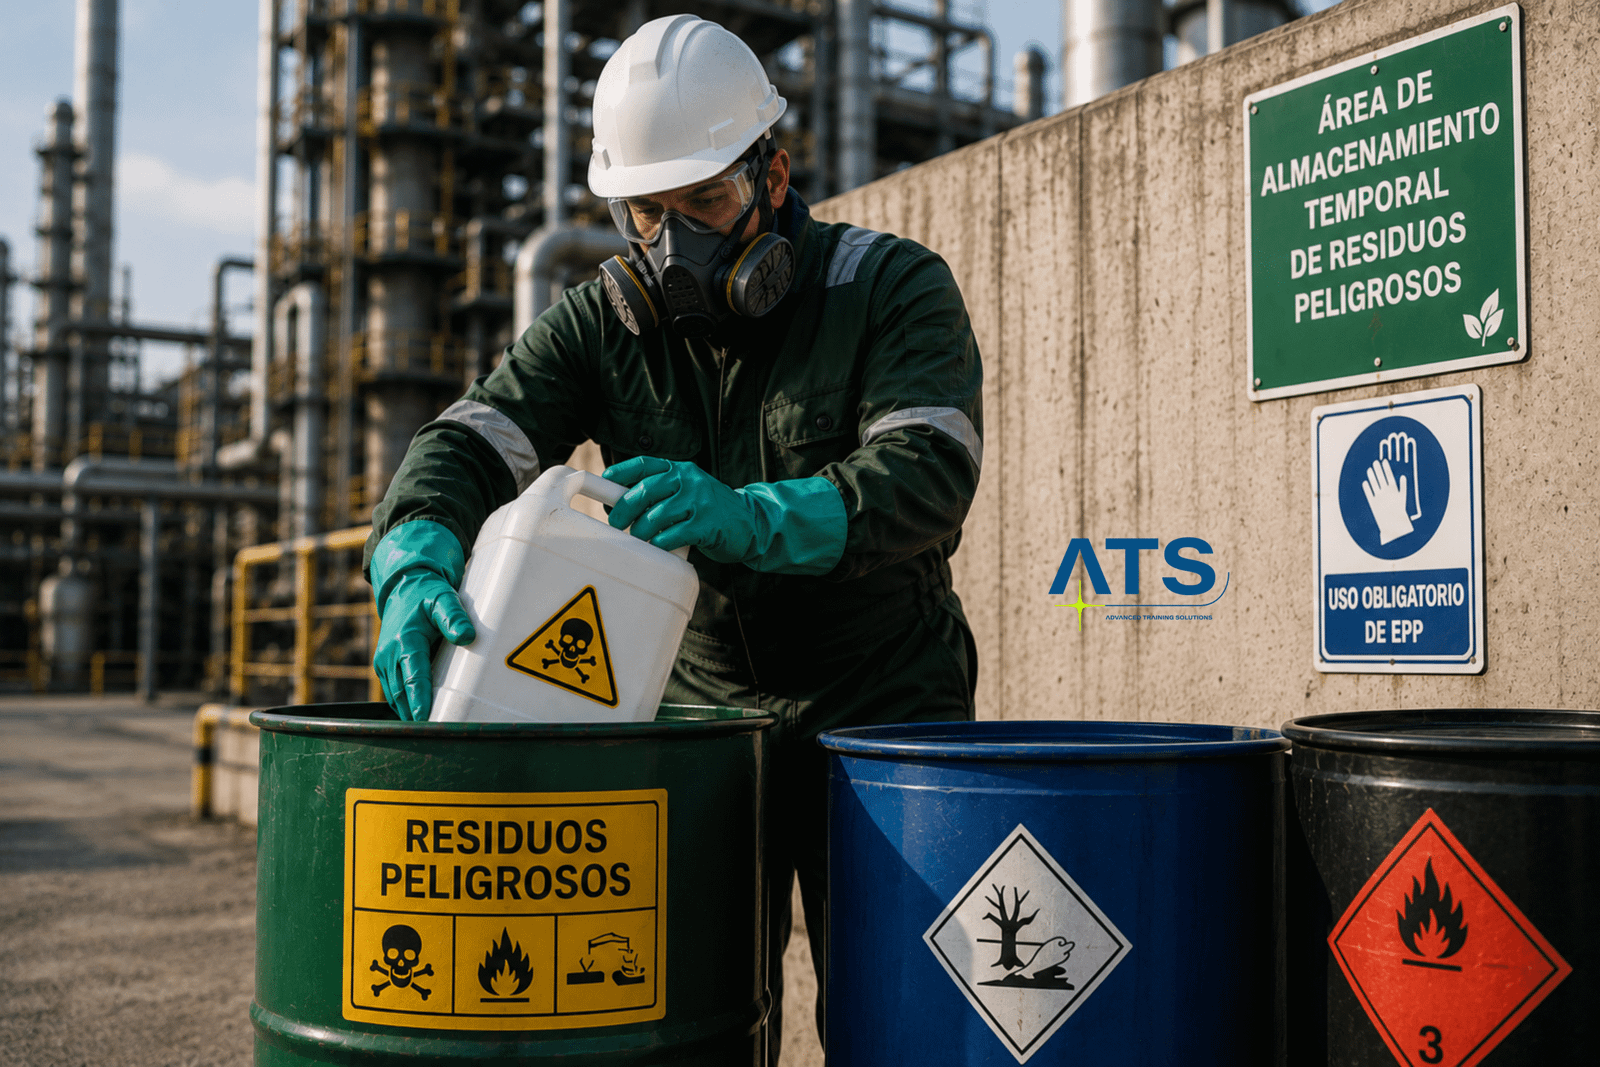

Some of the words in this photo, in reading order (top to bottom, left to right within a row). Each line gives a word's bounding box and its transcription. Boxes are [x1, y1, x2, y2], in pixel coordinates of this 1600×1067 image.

[1318, 86, 1388, 135] ÁREA
[1397, 69, 1433, 110] DE
[1260, 102, 1500, 197] ALMACENAMIENTO
[1304, 167, 1449, 230] TEMPORAL
[1291, 244, 1322, 279] DE
[1329, 211, 1466, 271] RESIDUOS
[1295, 261, 1462, 323] PELIGROSOS
[1328, 587, 1358, 610] USO
[1361, 582, 1464, 610] OBLIGATORIO
[1365, 620, 1386, 644] DE
[1390, 619, 1424, 644] EPP
[405, 819, 608, 855] RESIDUOS
[380, 862, 631, 900] PELIGROSOS
[1418, 1025, 1444, 1065] 3
